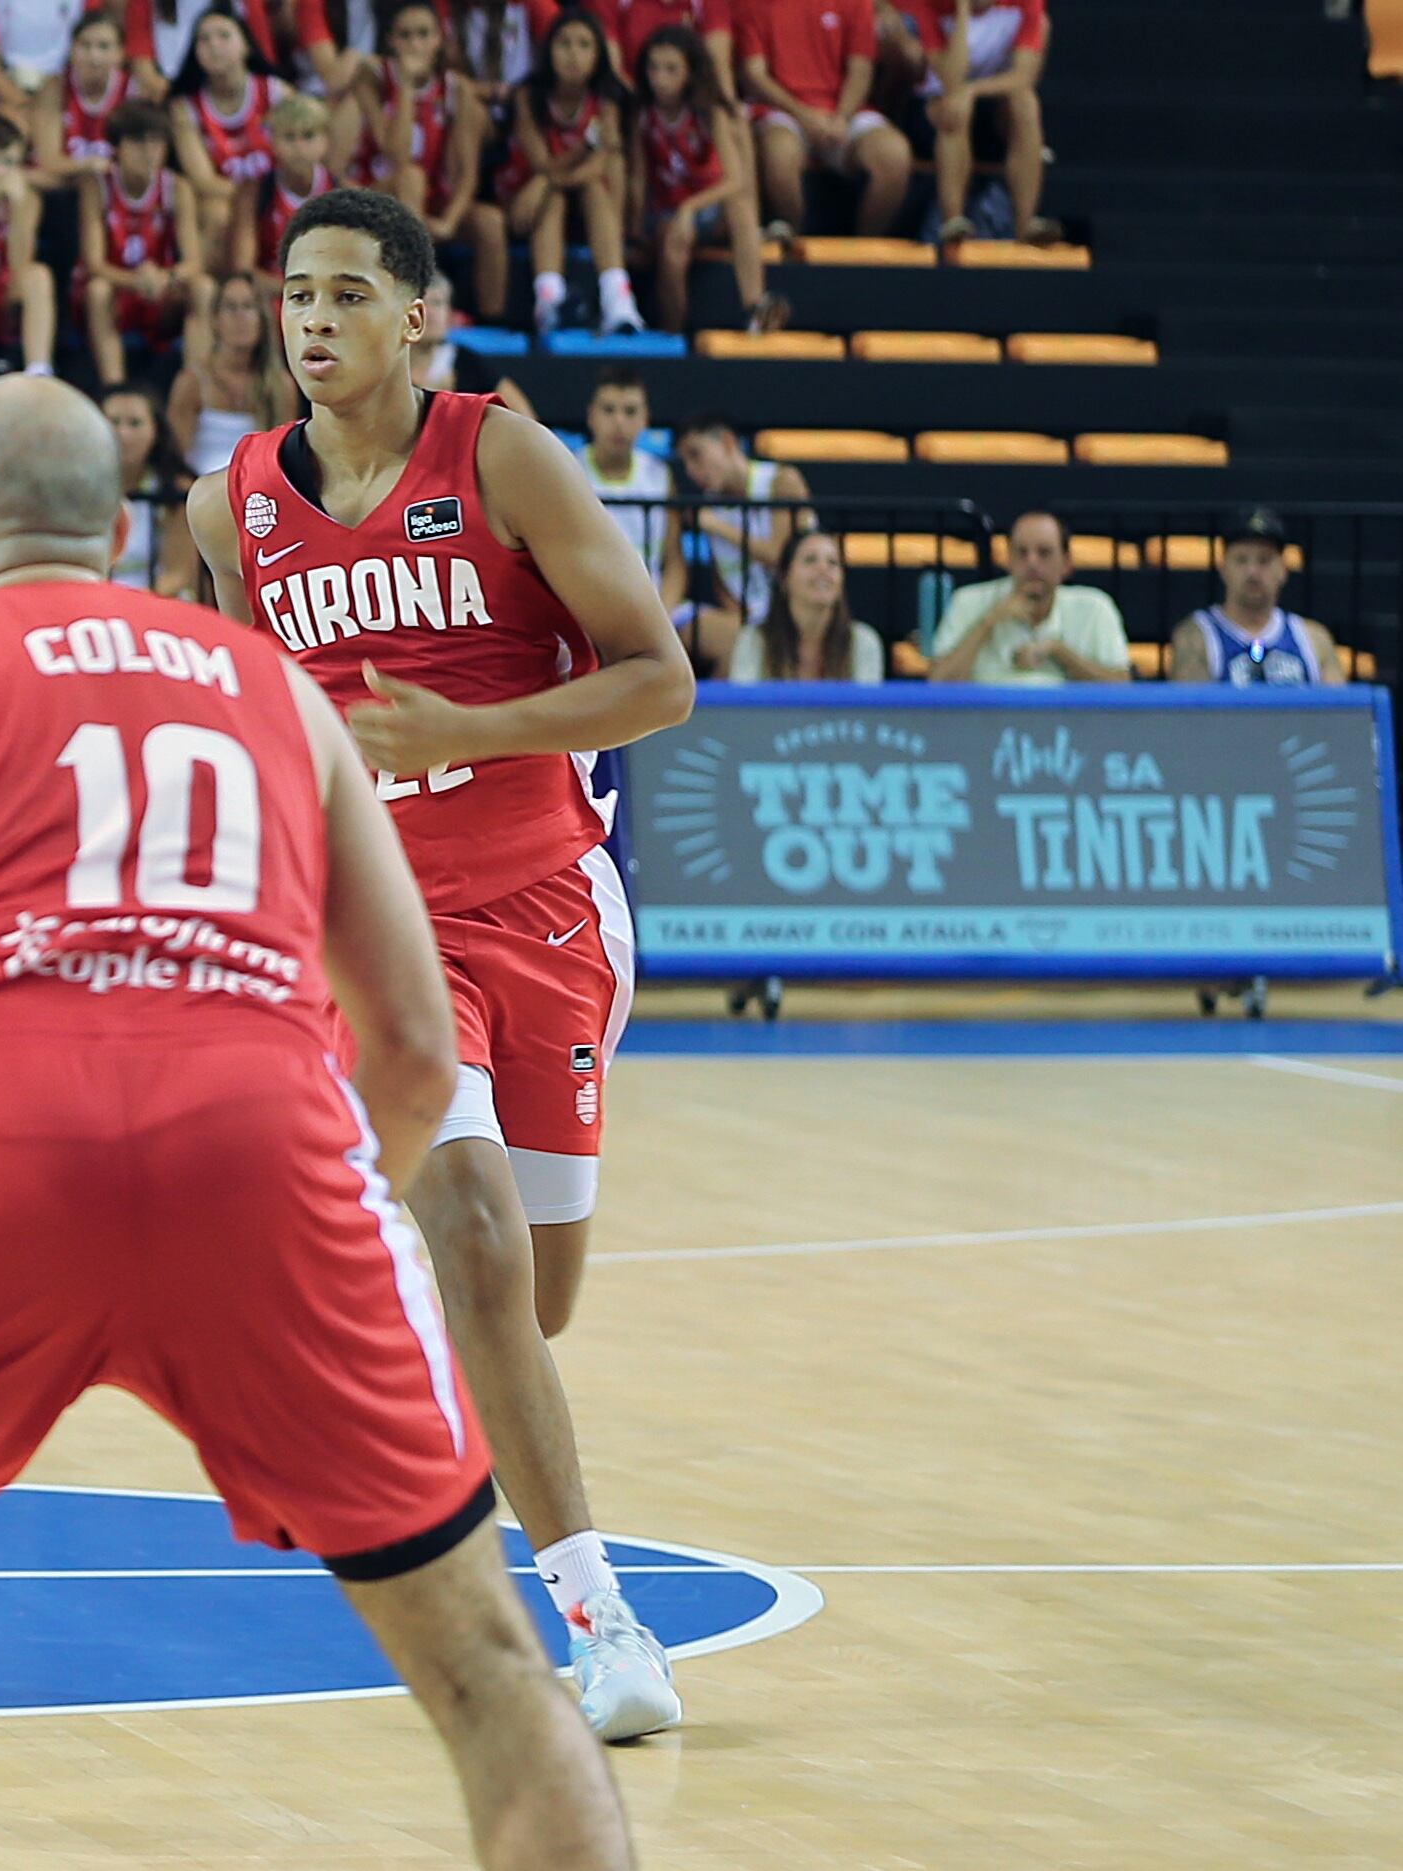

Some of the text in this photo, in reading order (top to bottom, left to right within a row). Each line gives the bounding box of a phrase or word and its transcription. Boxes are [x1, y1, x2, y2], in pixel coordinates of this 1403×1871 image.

[410, 514, 433, 527] liga
[411, 520, 459, 537] endesa
[259, 556, 494, 652] GIRONA
[22, 617, 242, 698] COLOM
[738, 760, 972, 830] TIME
[1103, 750, 1165, 791] SA
[54, 721, 262, 914] 10
[996, 793, 1275, 892] TINTINA
[762, 824, 956, 895] OUT
[658, 919, 728, 943] TAKE
[741, 919, 817, 943] AWAY
